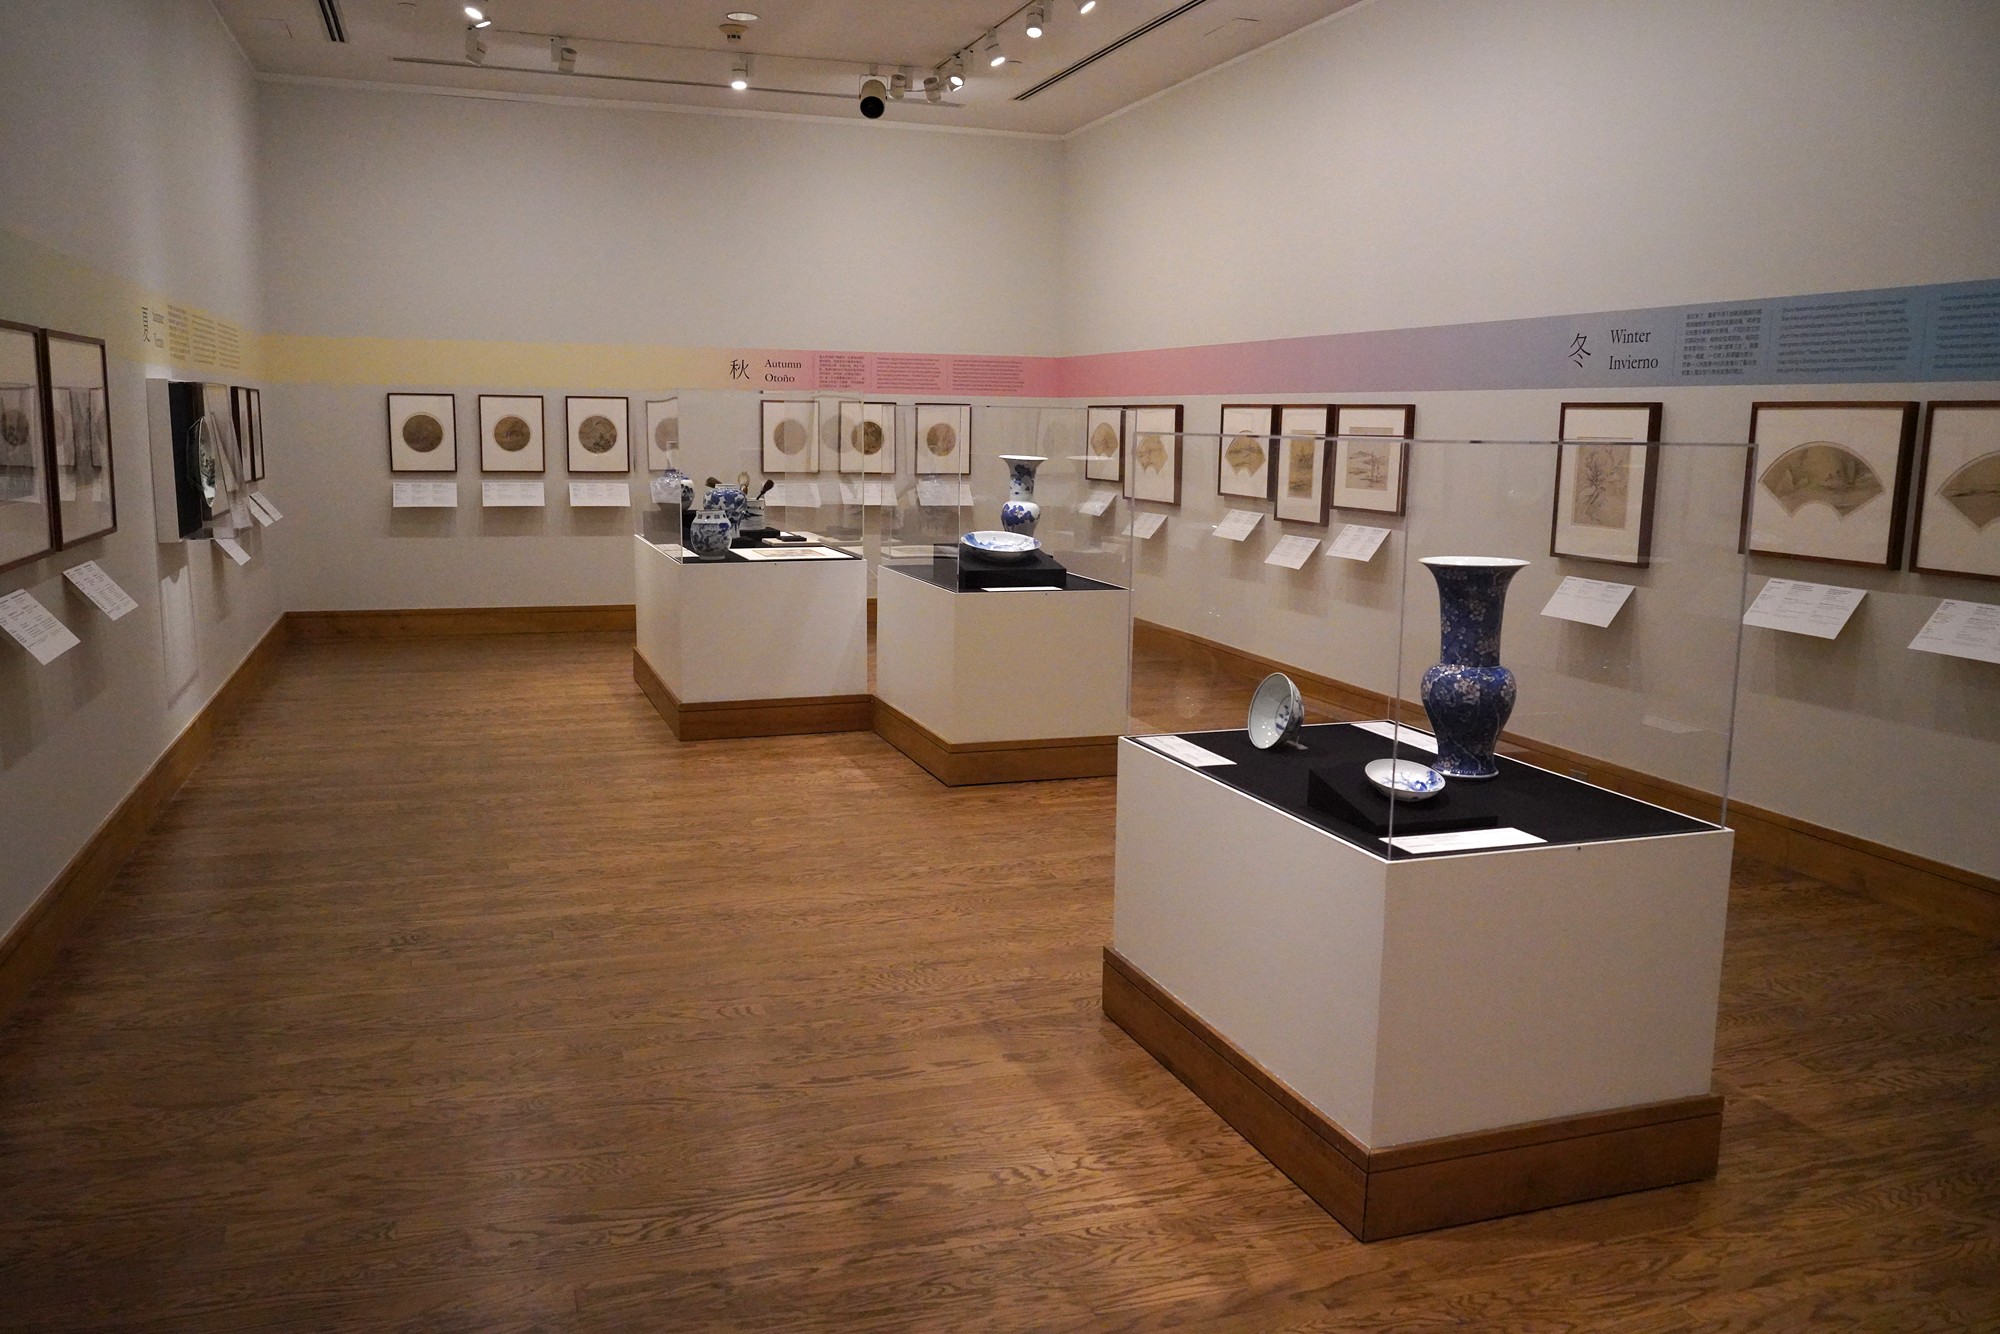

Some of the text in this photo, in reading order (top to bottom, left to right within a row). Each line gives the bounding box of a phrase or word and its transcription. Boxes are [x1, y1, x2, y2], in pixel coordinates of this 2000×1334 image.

[1611, 329, 1651, 344] Winter
[1568, 333, 1591, 368] 冬
[730, 359, 750, 380] 秋
[765, 359, 802, 369] Autumn
[1609, 354, 1659, 370] Invierno
[765, 373, 795, 383] Otoño
